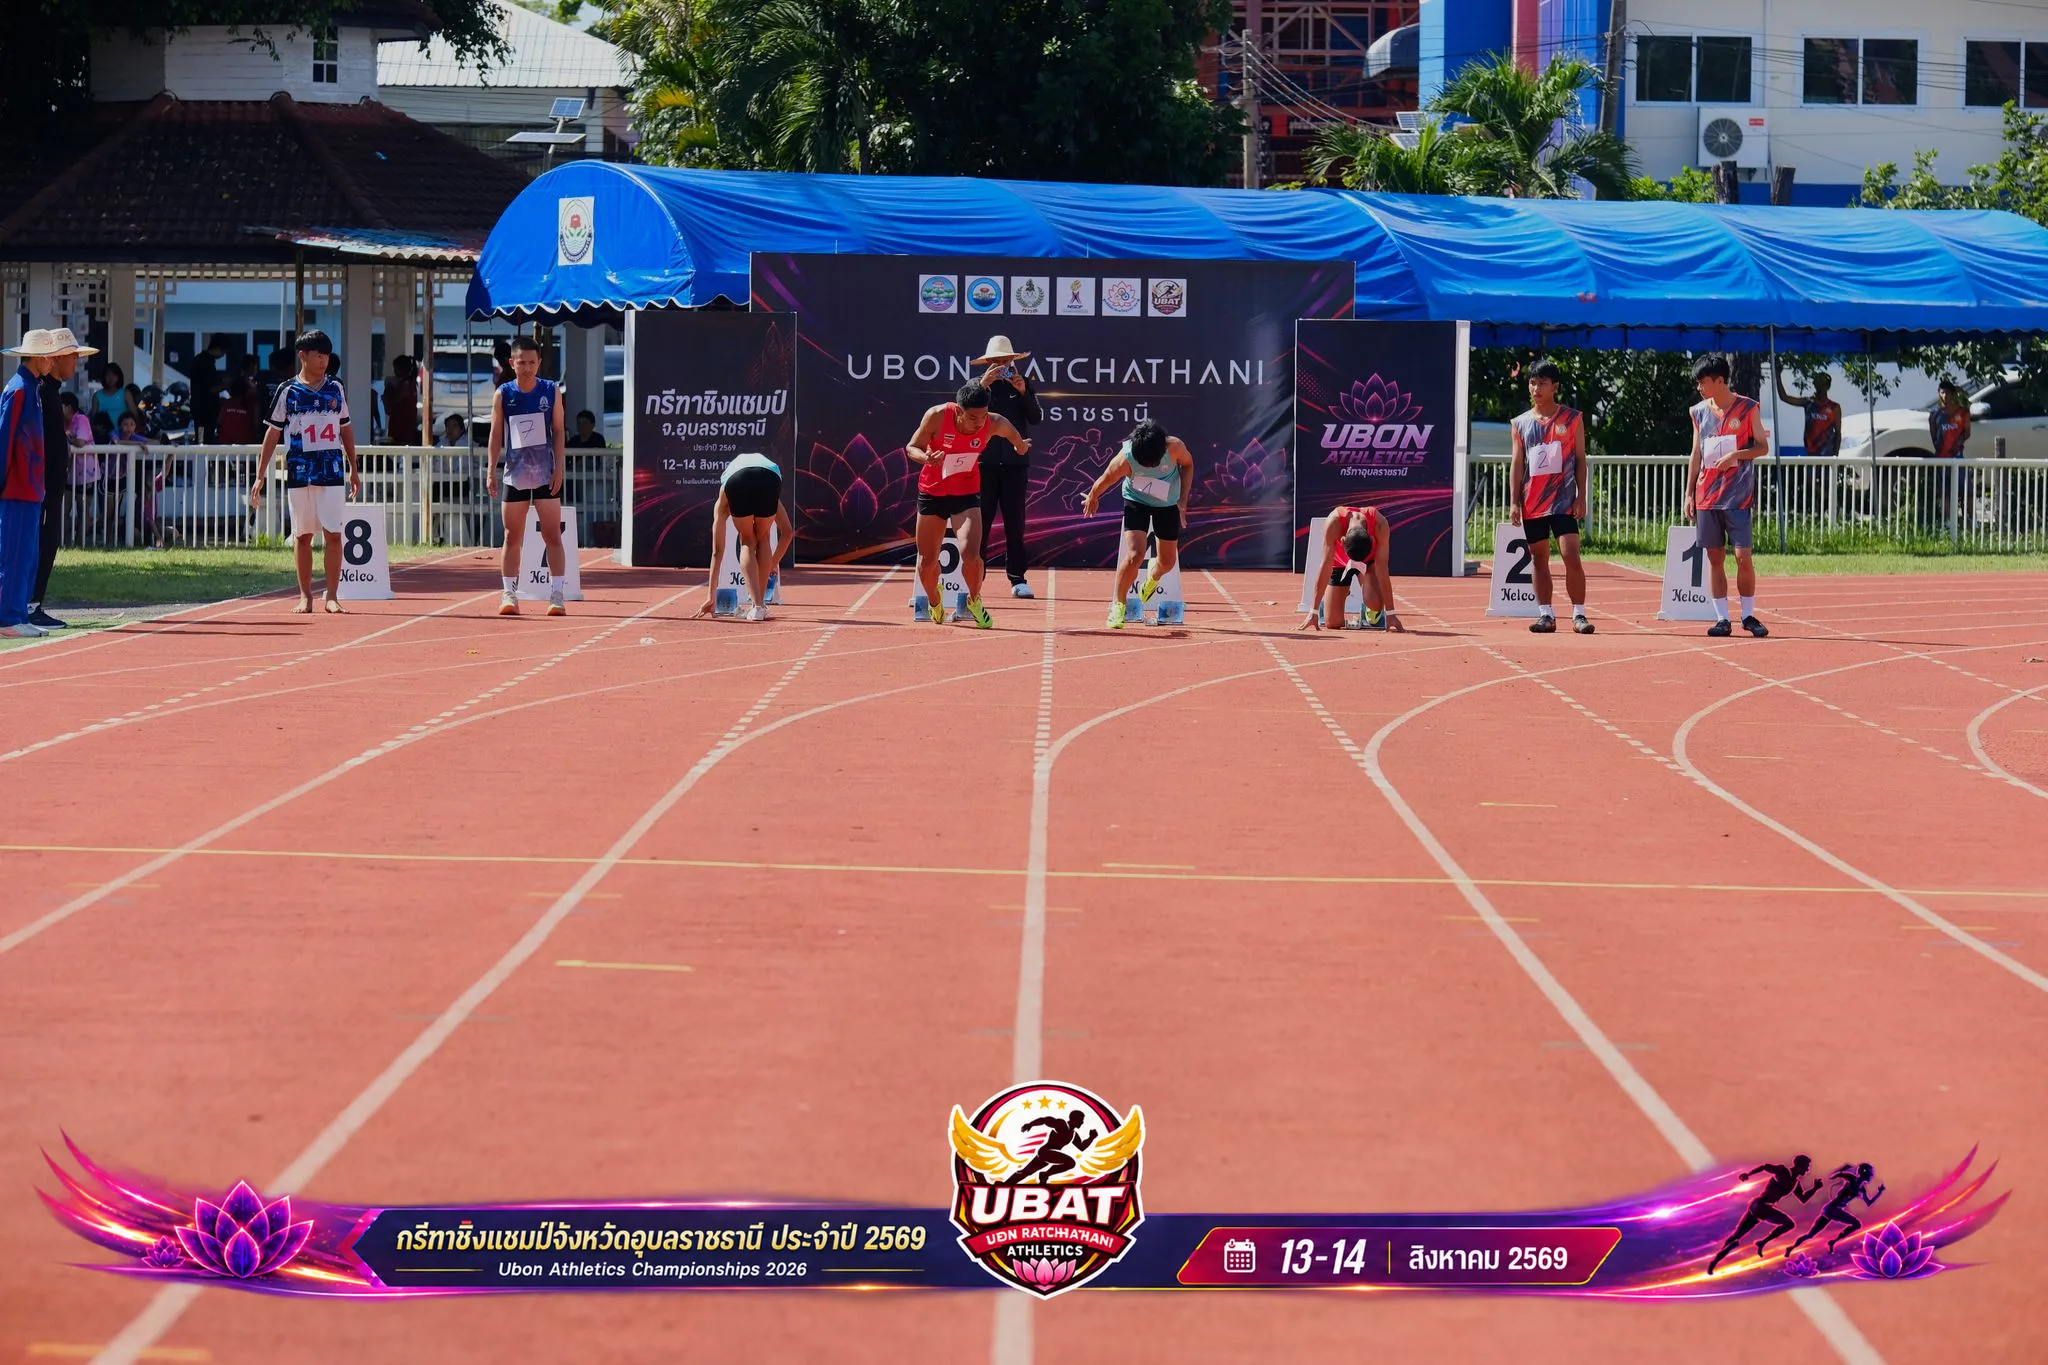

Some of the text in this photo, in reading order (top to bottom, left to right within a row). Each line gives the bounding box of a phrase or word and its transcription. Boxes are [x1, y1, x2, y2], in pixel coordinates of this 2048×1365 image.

[847, 354, 1263, 385] UBON ATCHATHANI
[645, 388, 788, 415] กรีฑาชิงแชมป์
[1040, 402, 1148, 422] ราชธานี
[304, 423, 336, 443] 14
[520, 420, 535, 440] 7
[662, 418, 767, 440] จ.อุบลราชธานี
[1320, 424, 1435, 449] UBON
[693, 443, 717, 451] ประจำปี
[700, 459, 731, 470] สิงหาค
[1322, 451, 1429, 465] ATHLETICS
[1538, 451, 1549, 470] 2
[344, 519, 373, 565] 8
[1506, 538, 1532, 583] 2
[1682, 541, 1703, 587] 1
[340, 570, 374, 582] Nelco
[530, 570, 550, 584] Nel
[1501, 588, 1535, 602] Nelco
[1672, 589, 1706, 603] Nelco
